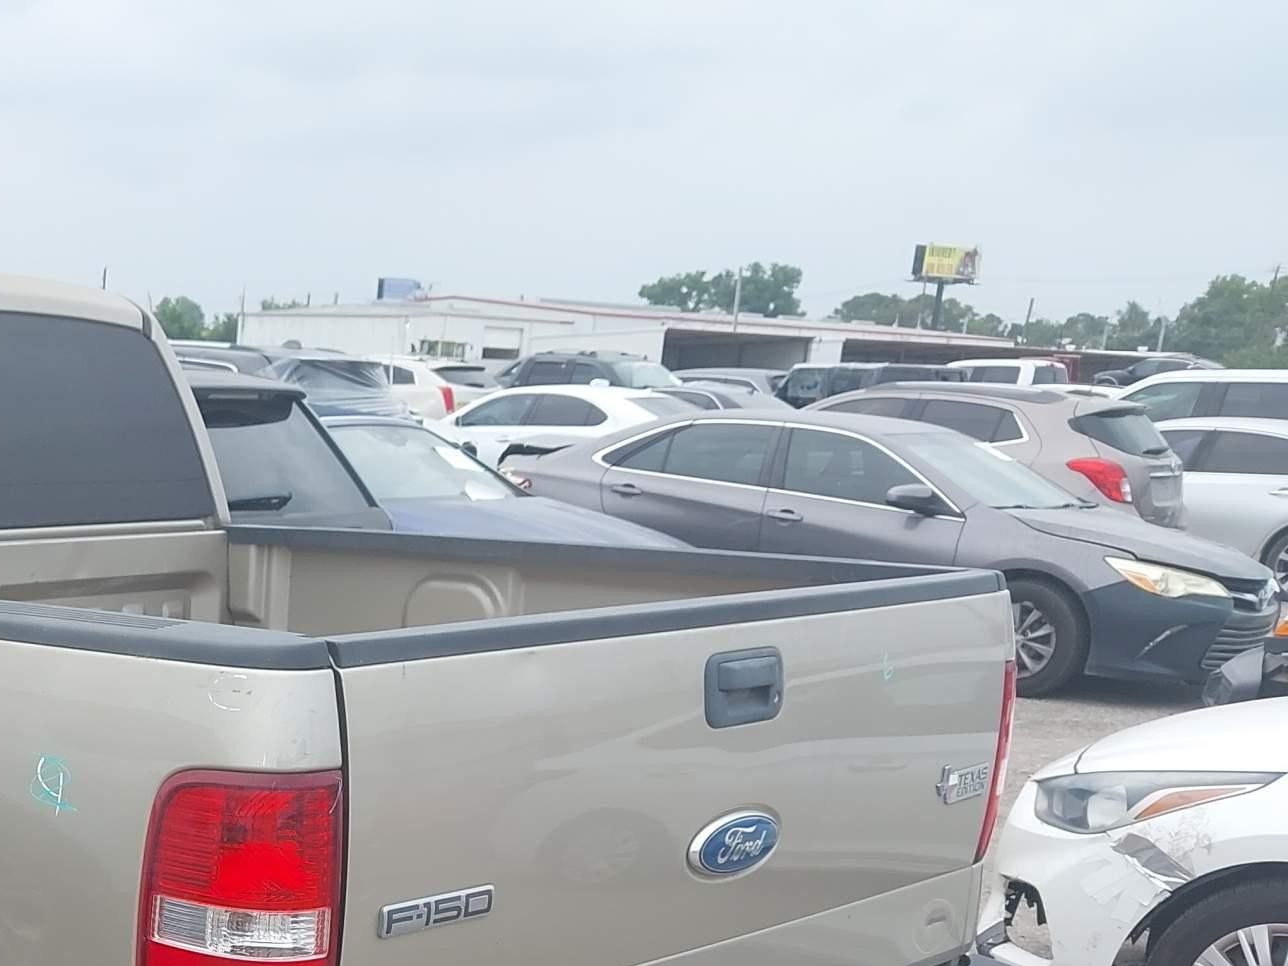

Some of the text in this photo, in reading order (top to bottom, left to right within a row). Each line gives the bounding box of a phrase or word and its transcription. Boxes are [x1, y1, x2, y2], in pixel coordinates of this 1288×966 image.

[958, 766, 988, 787] TEXAS
[956, 782, 985, 798] EDITION
[717, 825, 768, 865] Ford
